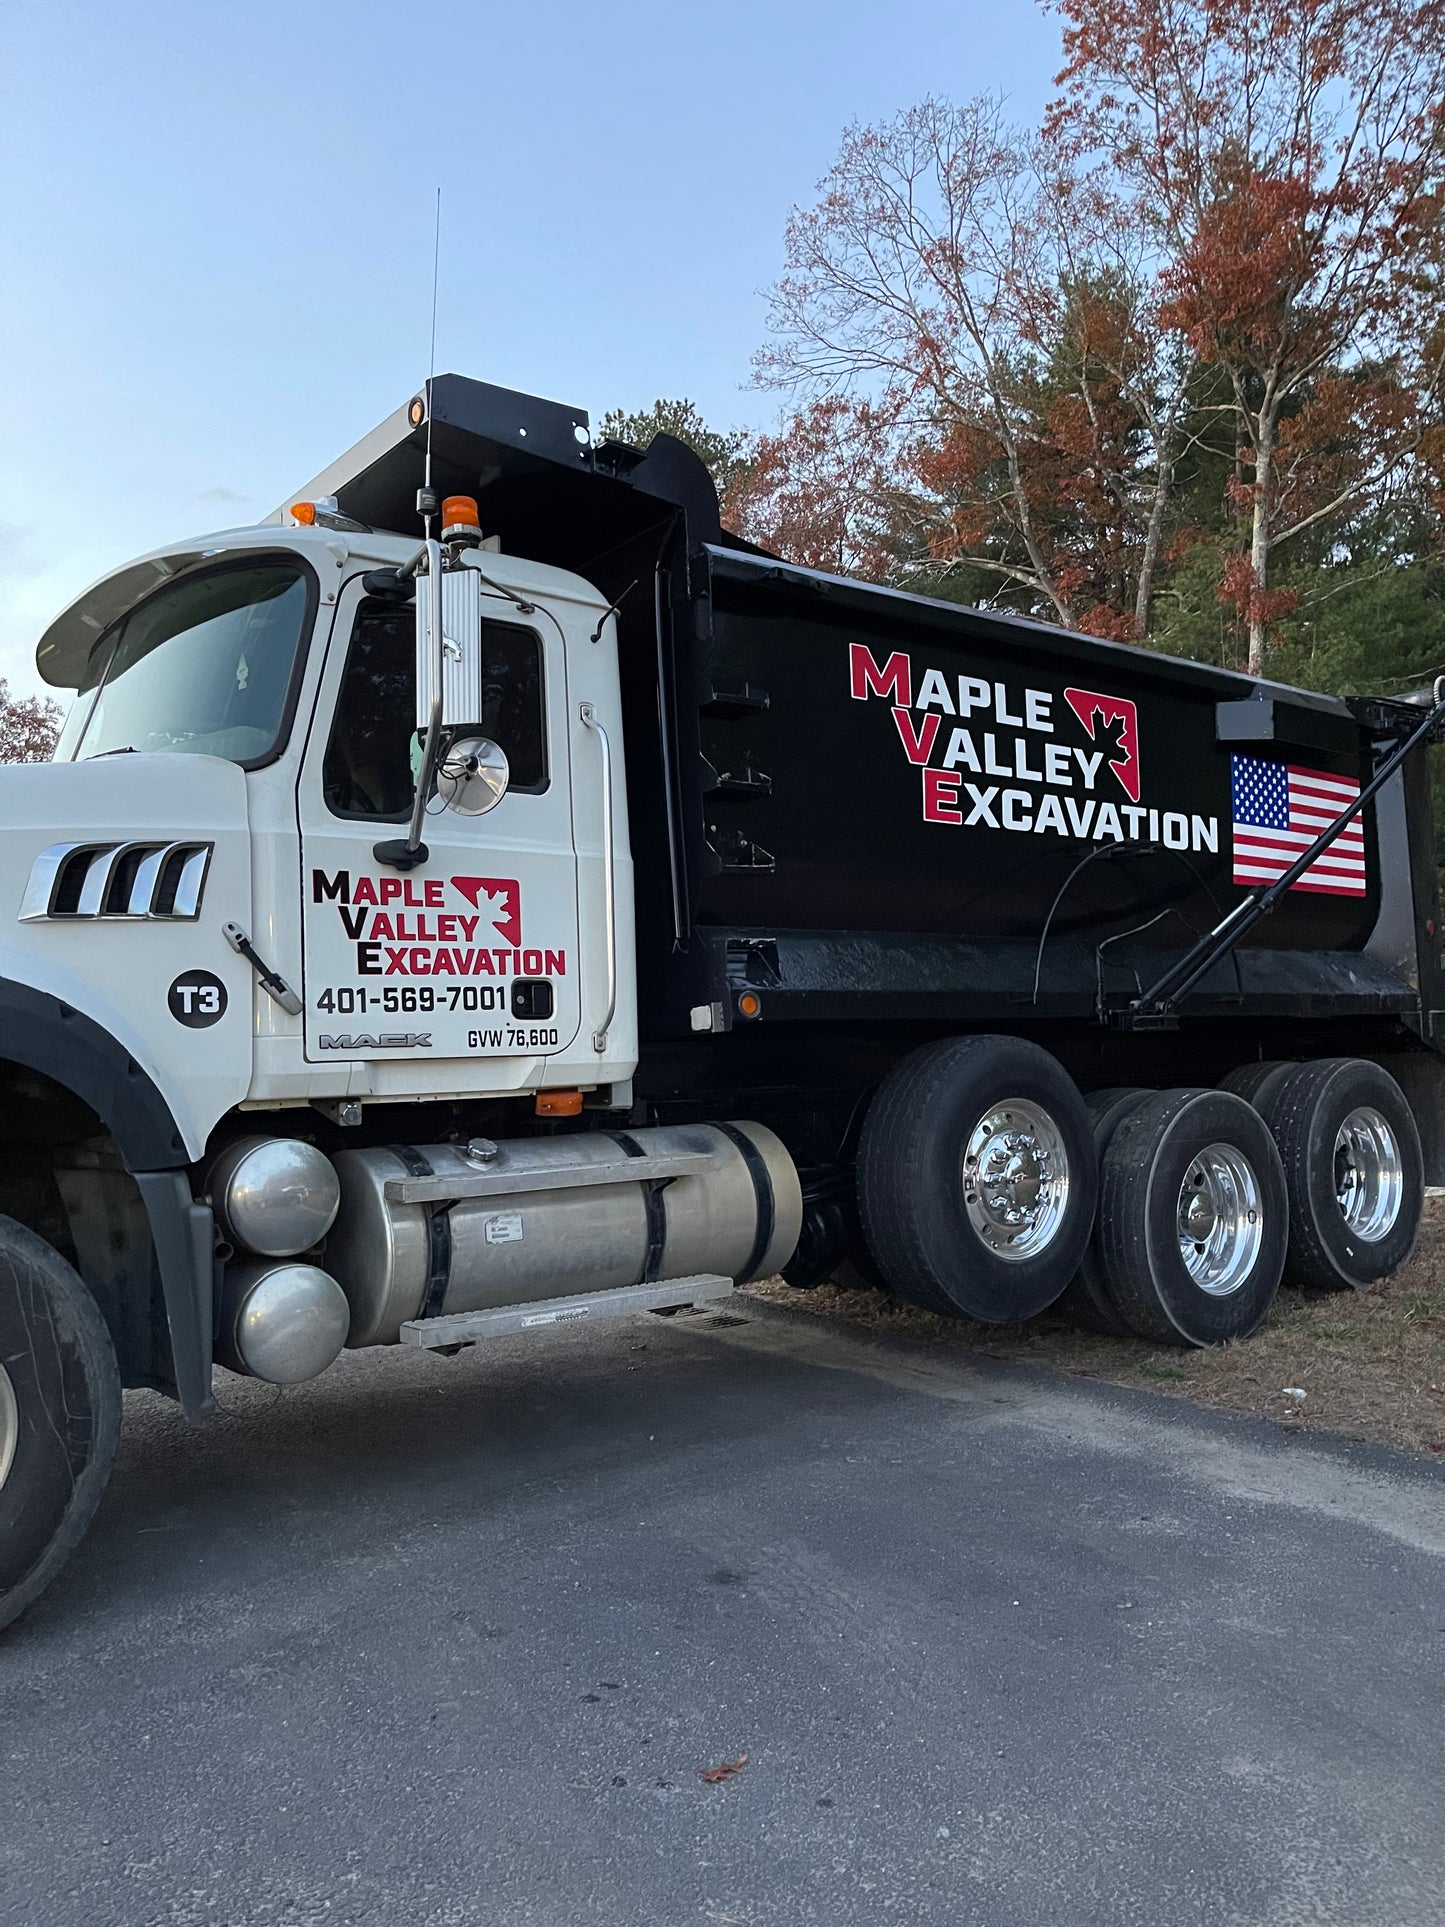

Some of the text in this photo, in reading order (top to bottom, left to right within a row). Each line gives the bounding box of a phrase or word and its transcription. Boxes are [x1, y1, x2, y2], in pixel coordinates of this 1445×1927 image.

[849, 643, 1054, 732] MAPLE
[891, 707, 1104, 790] VALLEY
[922, 767, 1219, 853] EXCAVATION
[312, 869, 445, 907] MAPLE
[338, 905, 480, 942] VALLEY
[357, 941, 565, 976] EXCAVATION
[176, 985, 221, 1014] T3
[316, 985, 506, 1014] 401-569-7001
[319, 1032, 432, 1050] MACK
[467, 1028, 558, 1049] GVW 76,600
